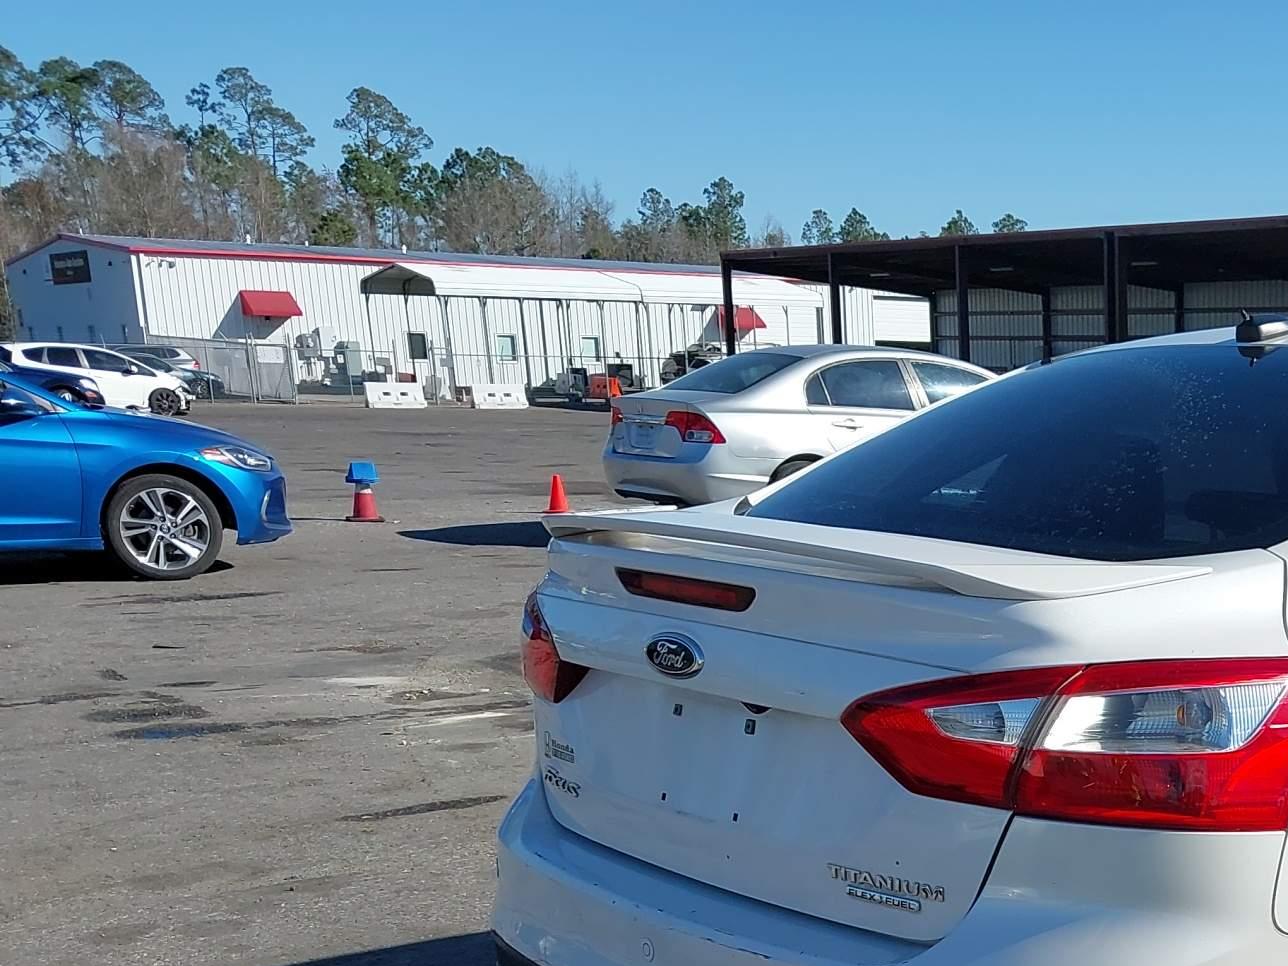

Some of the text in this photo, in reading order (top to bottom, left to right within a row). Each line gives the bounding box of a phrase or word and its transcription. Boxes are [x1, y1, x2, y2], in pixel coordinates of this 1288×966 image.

[653, 641, 687, 668] Ford
[551, 738, 575, 755] Honda
[827, 862, 945, 902] TITANIUM
[846, 887, 917, 911] FLEX FUEL
